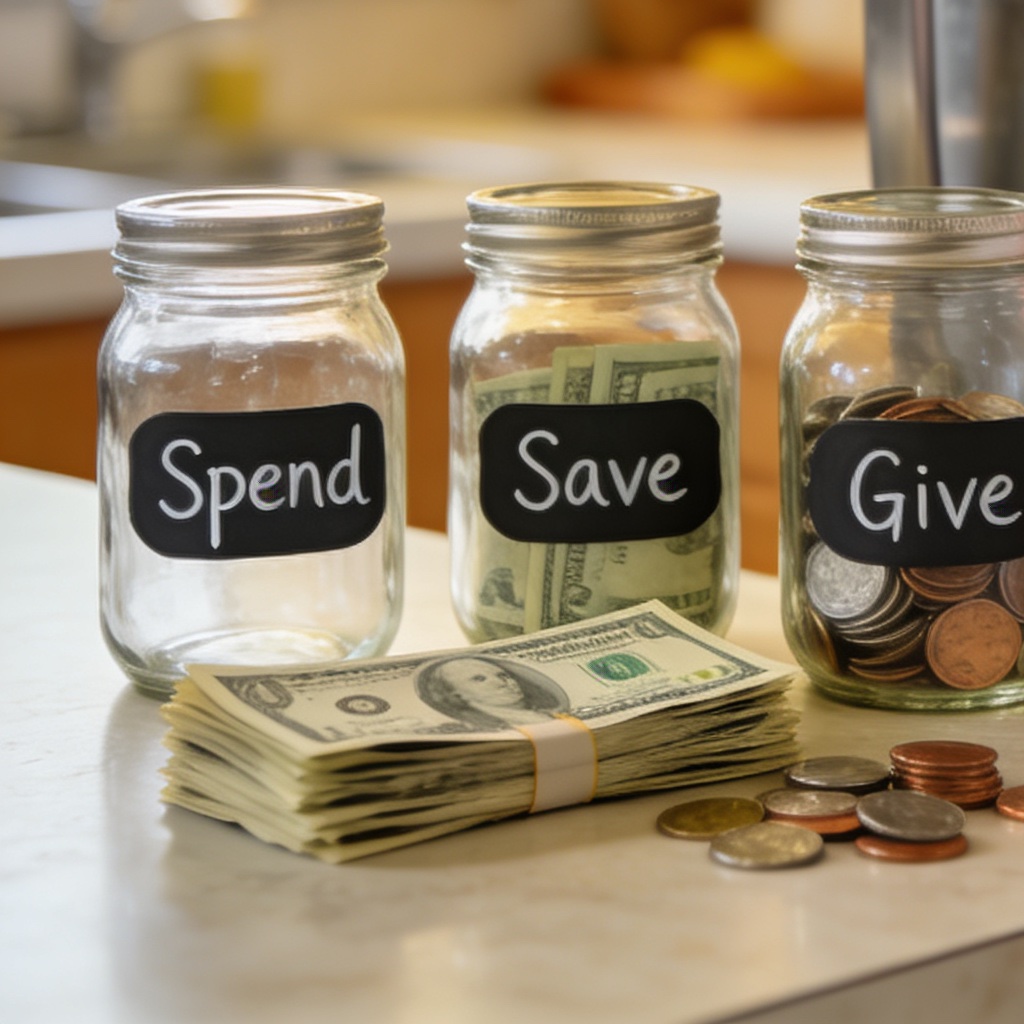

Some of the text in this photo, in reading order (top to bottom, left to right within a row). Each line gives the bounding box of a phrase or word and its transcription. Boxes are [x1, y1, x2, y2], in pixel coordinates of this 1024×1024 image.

[157, 424, 371, 550] Spend
[514, 429, 688, 512] Save
[849, 448, 1022, 542] Give
